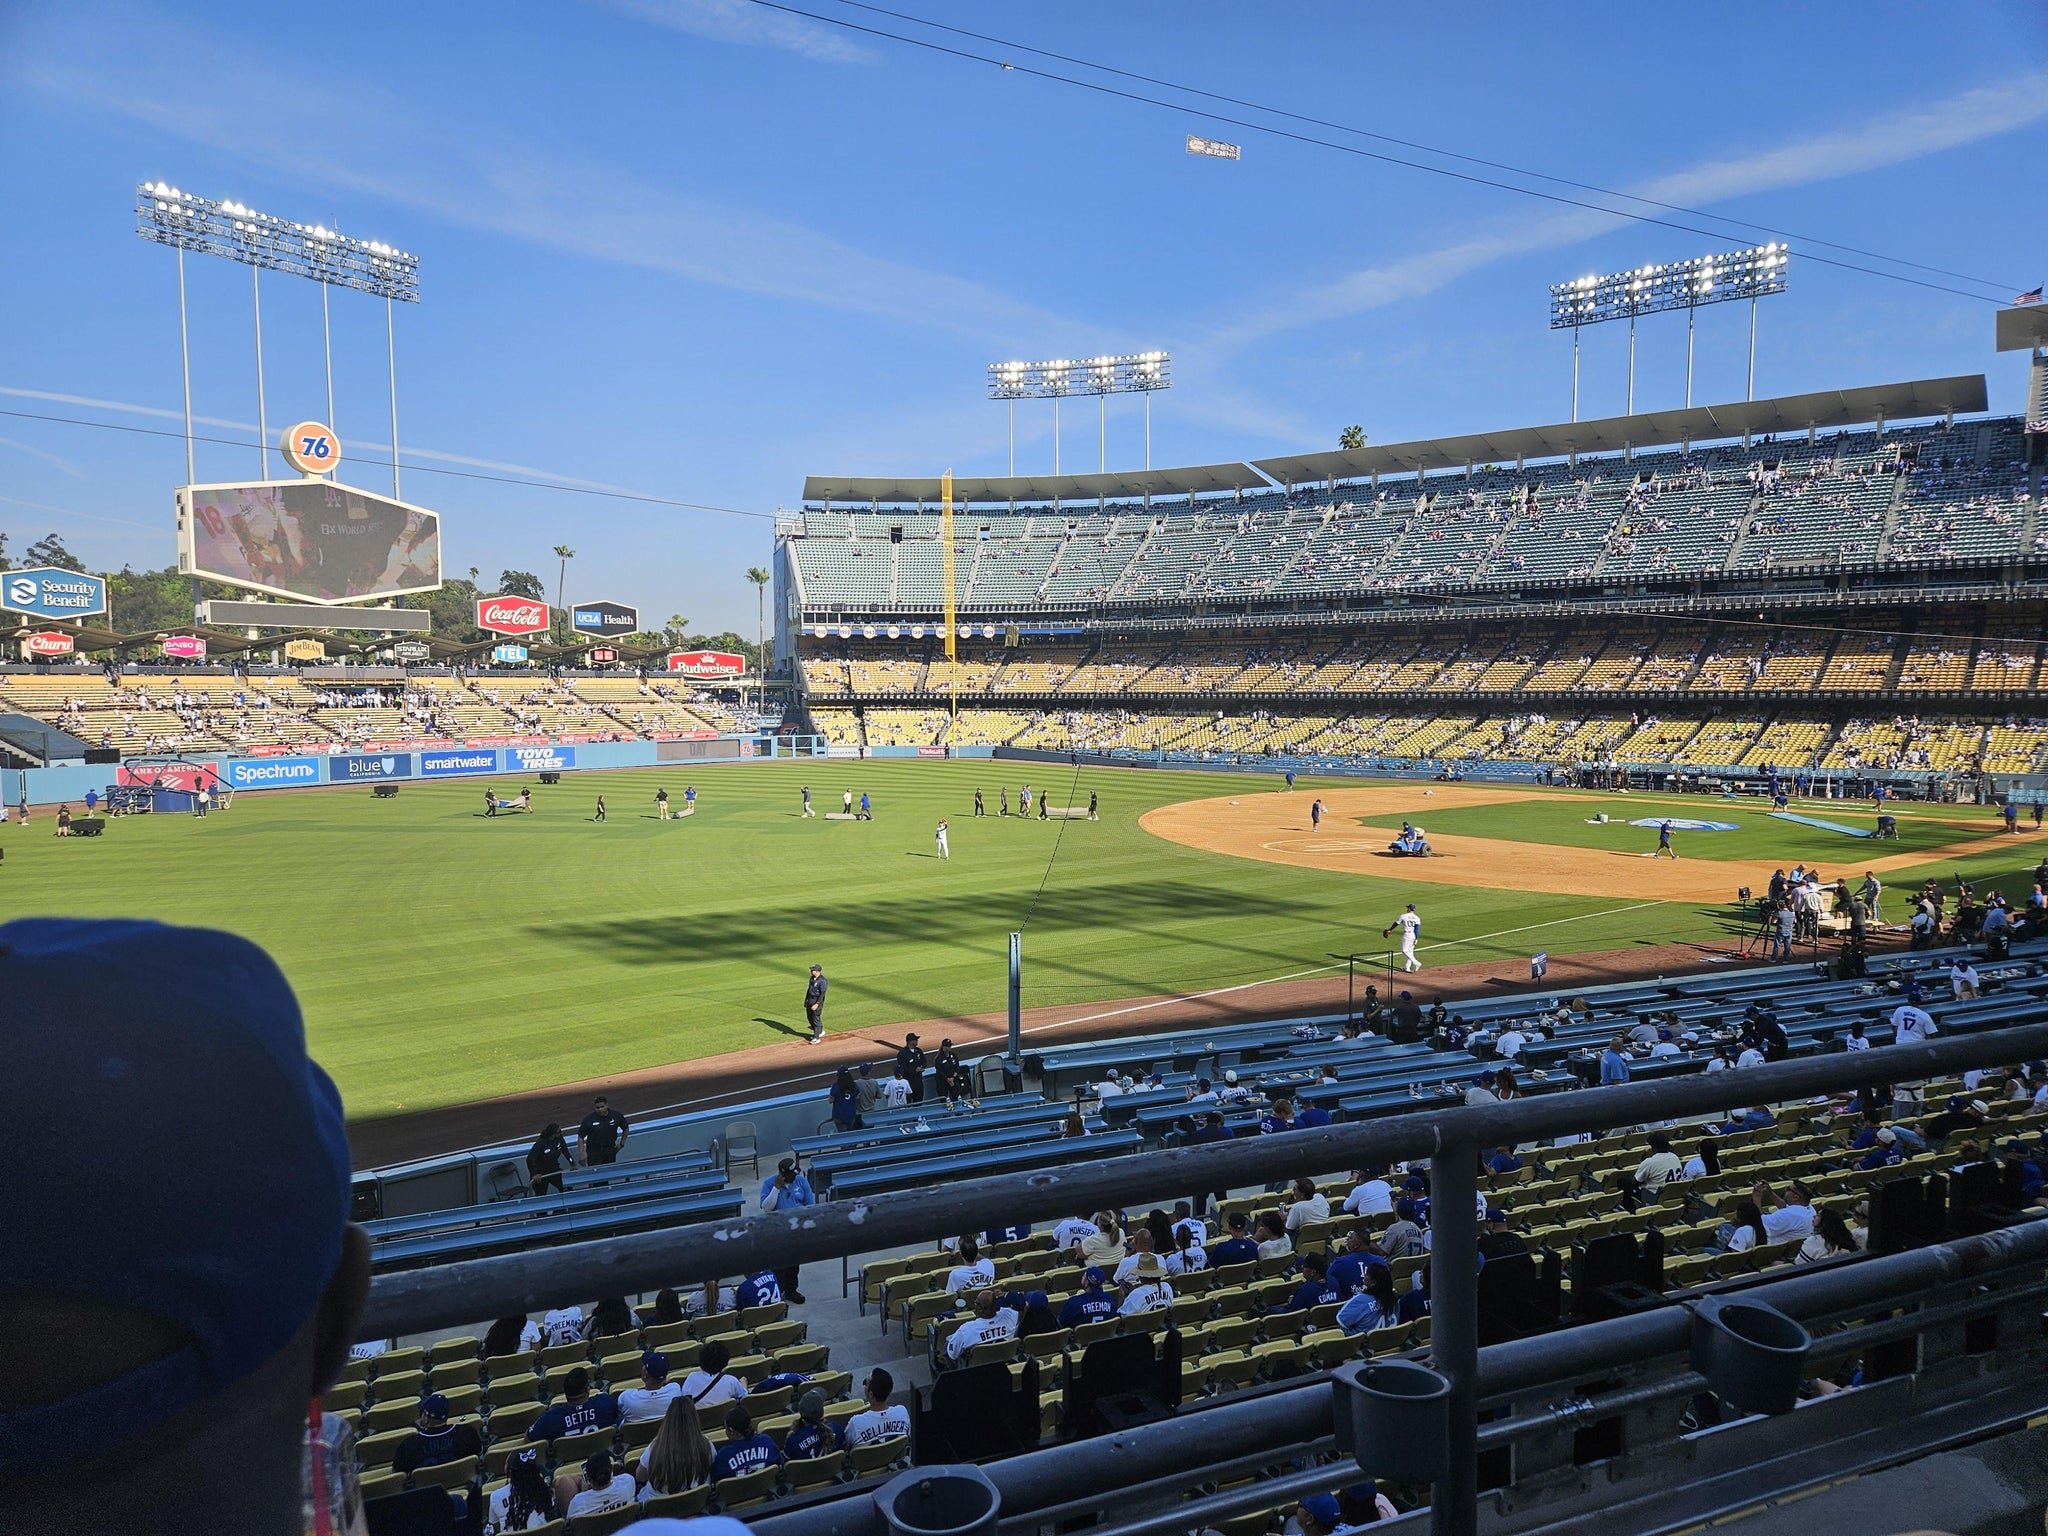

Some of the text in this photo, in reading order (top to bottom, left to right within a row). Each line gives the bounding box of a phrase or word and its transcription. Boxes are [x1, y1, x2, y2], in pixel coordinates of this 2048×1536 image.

[302, 436, 330, 459] 76
[41, 579, 97, 597] Security
[43, 593, 91, 608] Benefit
[485, 604, 543, 626] Coca-Cola
[577, 613, 634, 626] UCLA Health
[28, 637, 73, 650] Churu
[165, 641, 194, 649] DAISO
[289, 643, 321, 656] JIM BEAM
[500, 648, 524, 660] TEL
[676, 661, 738, 674] Budweiser
[515, 748, 555, 760] TOYO
[689, 743, 707, 757] DAY
[350, 759, 380, 773] blue
[425, 756, 493, 770] smartwater
[522, 757, 564, 769] TIRES
[235, 765, 308, 784] Spectrum
[1903, 1017, 1916, 1031] 17
[1664, 1167, 1682, 1183] 42
[1005, 1226, 1017, 1242] 5
[1407, 1241, 1422, 1256] 17
[757, 1283, 782, 1307] 24
[1318, 1291, 1337, 1304] EDMAN
[1082, 1301, 1112, 1314] FREEMAN
[561, 1329, 573, 1346] 5
[979, 1326, 1007, 1342] BETTS
[564, 1408, 596, 1428] BETTS
[860, 1420, 906, 1442] BELLINGER
[728, 1446, 769, 1470] OHTANI
